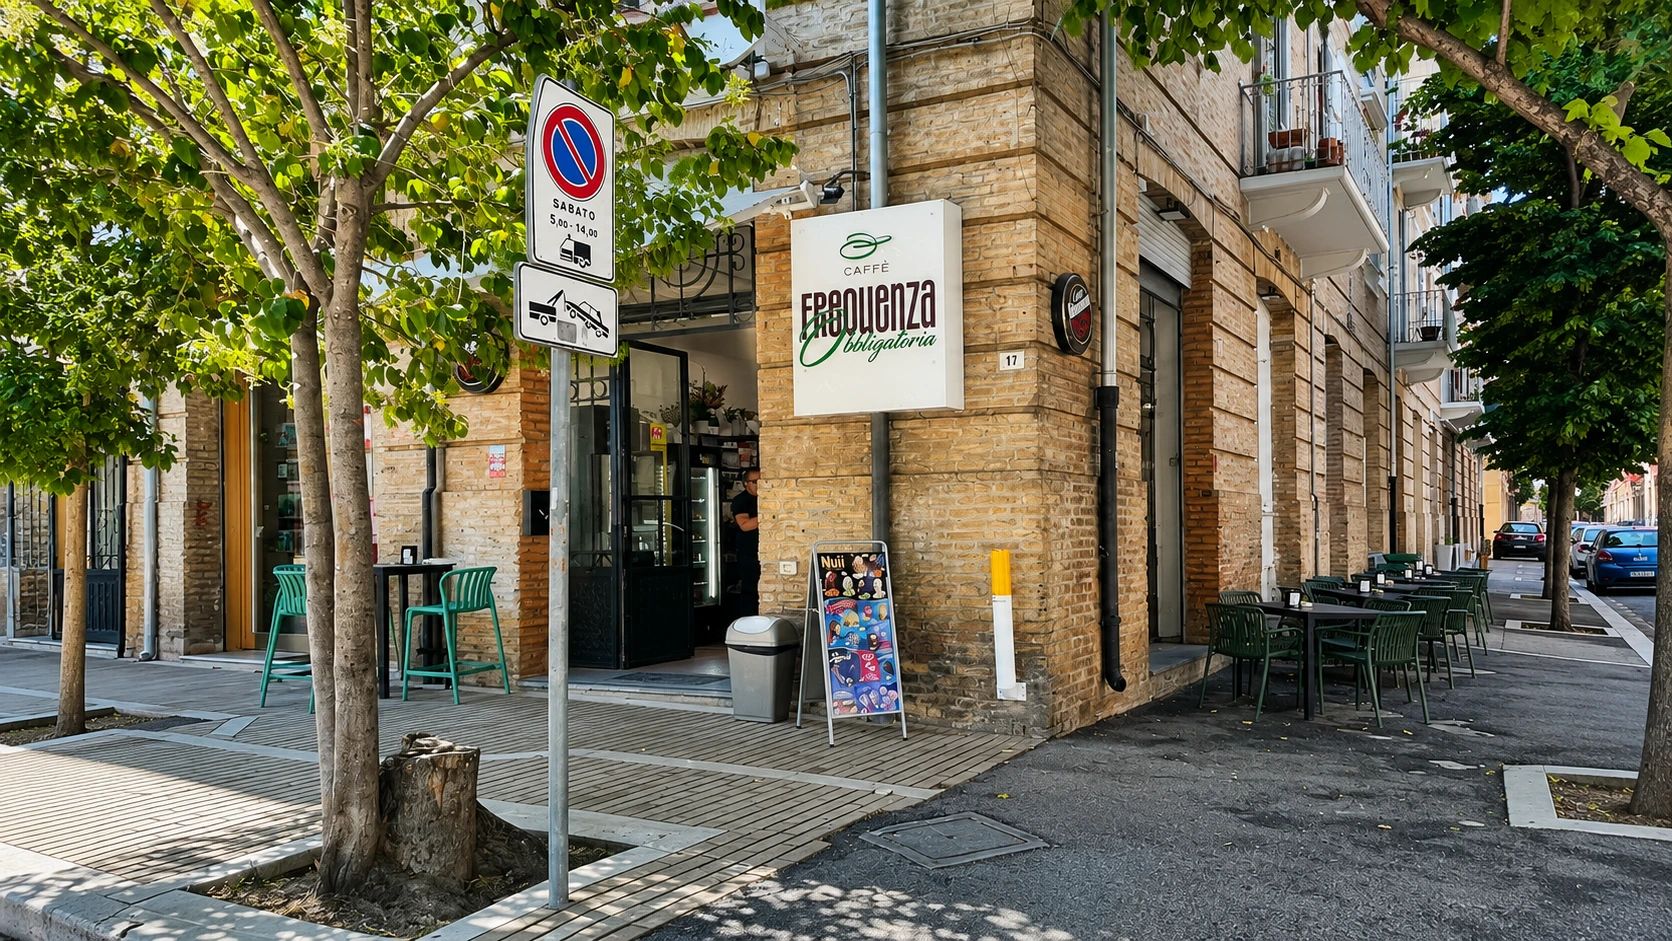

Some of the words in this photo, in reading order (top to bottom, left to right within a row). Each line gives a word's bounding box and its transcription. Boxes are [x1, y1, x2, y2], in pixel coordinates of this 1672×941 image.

[552, 198, 595, 221] SABATO
[550, 213, 568, 228] 5,00
[575, 223, 598, 238] 14,00
[843, 260, 890, 277] CAFFÈ
[799, 308, 938, 368] Obbligatoria
[1005, 354, 1018, 367] 17
[820, 554, 845, 569] Nuii
